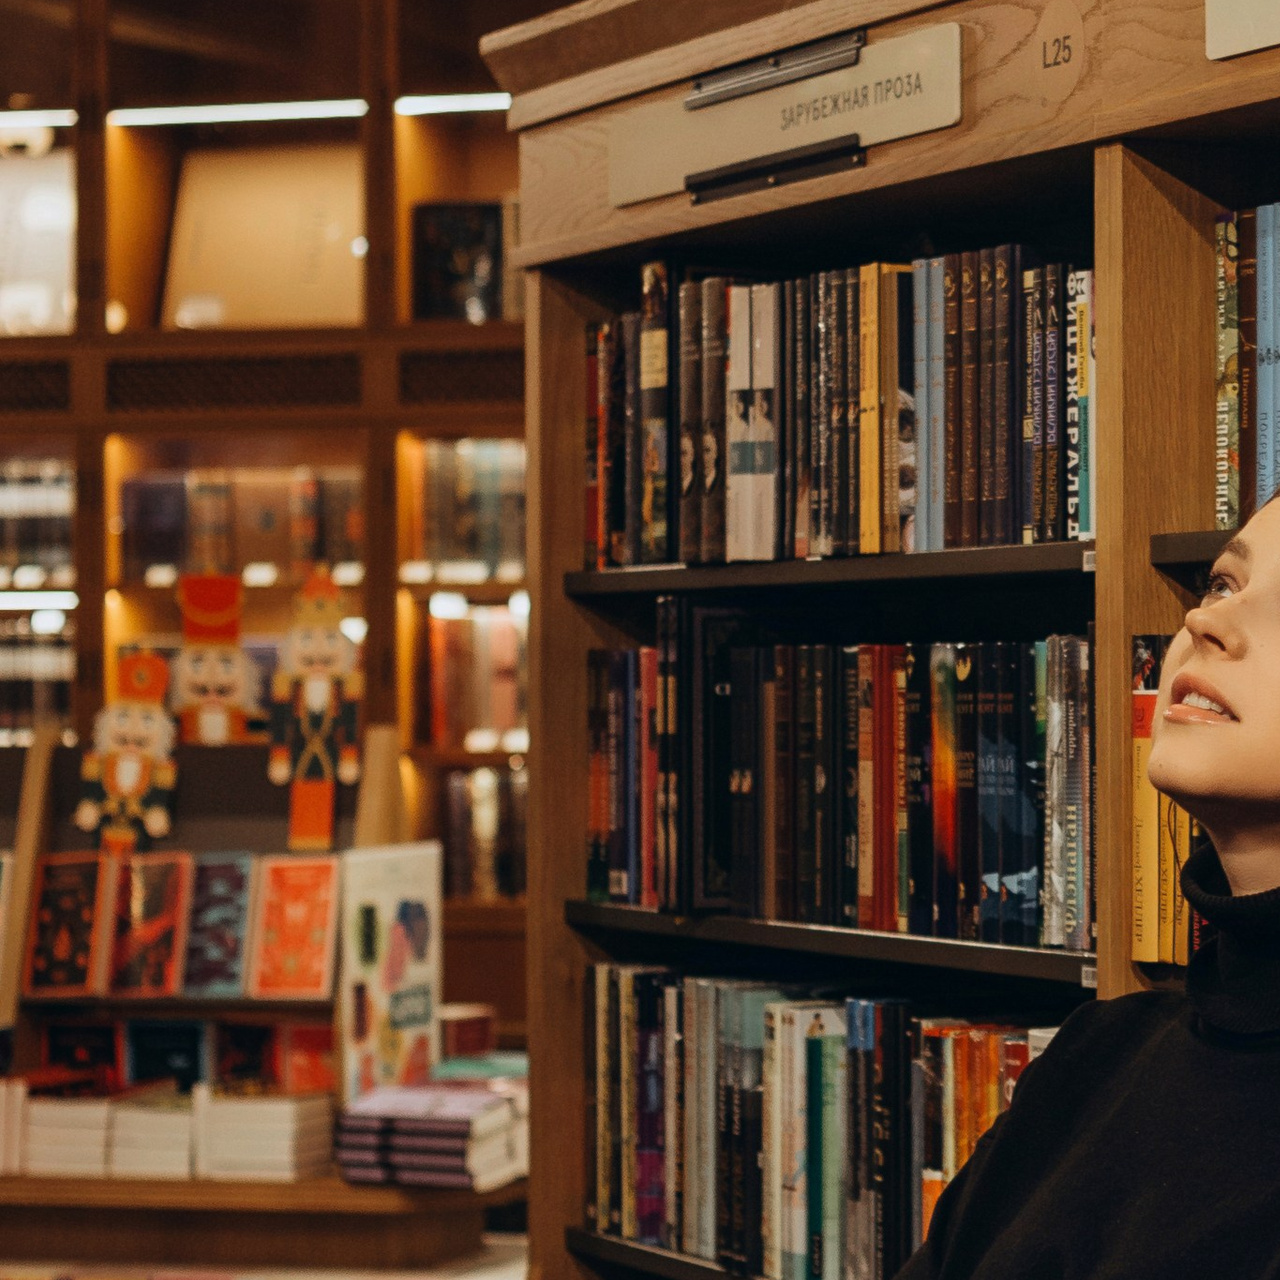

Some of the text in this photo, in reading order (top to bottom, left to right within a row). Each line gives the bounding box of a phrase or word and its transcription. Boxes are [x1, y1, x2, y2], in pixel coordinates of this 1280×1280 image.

[1042, 35, 1072, 69] L25
[780, 73, 923, 131] ЗАРУБЕЖНАЯ ПРОЗА
[1065, 272, 1079, 540] ФИЦДЖЕРАЛЬД
[1216, 402, 1229, 523] НЕПОКОРНЫЕ
